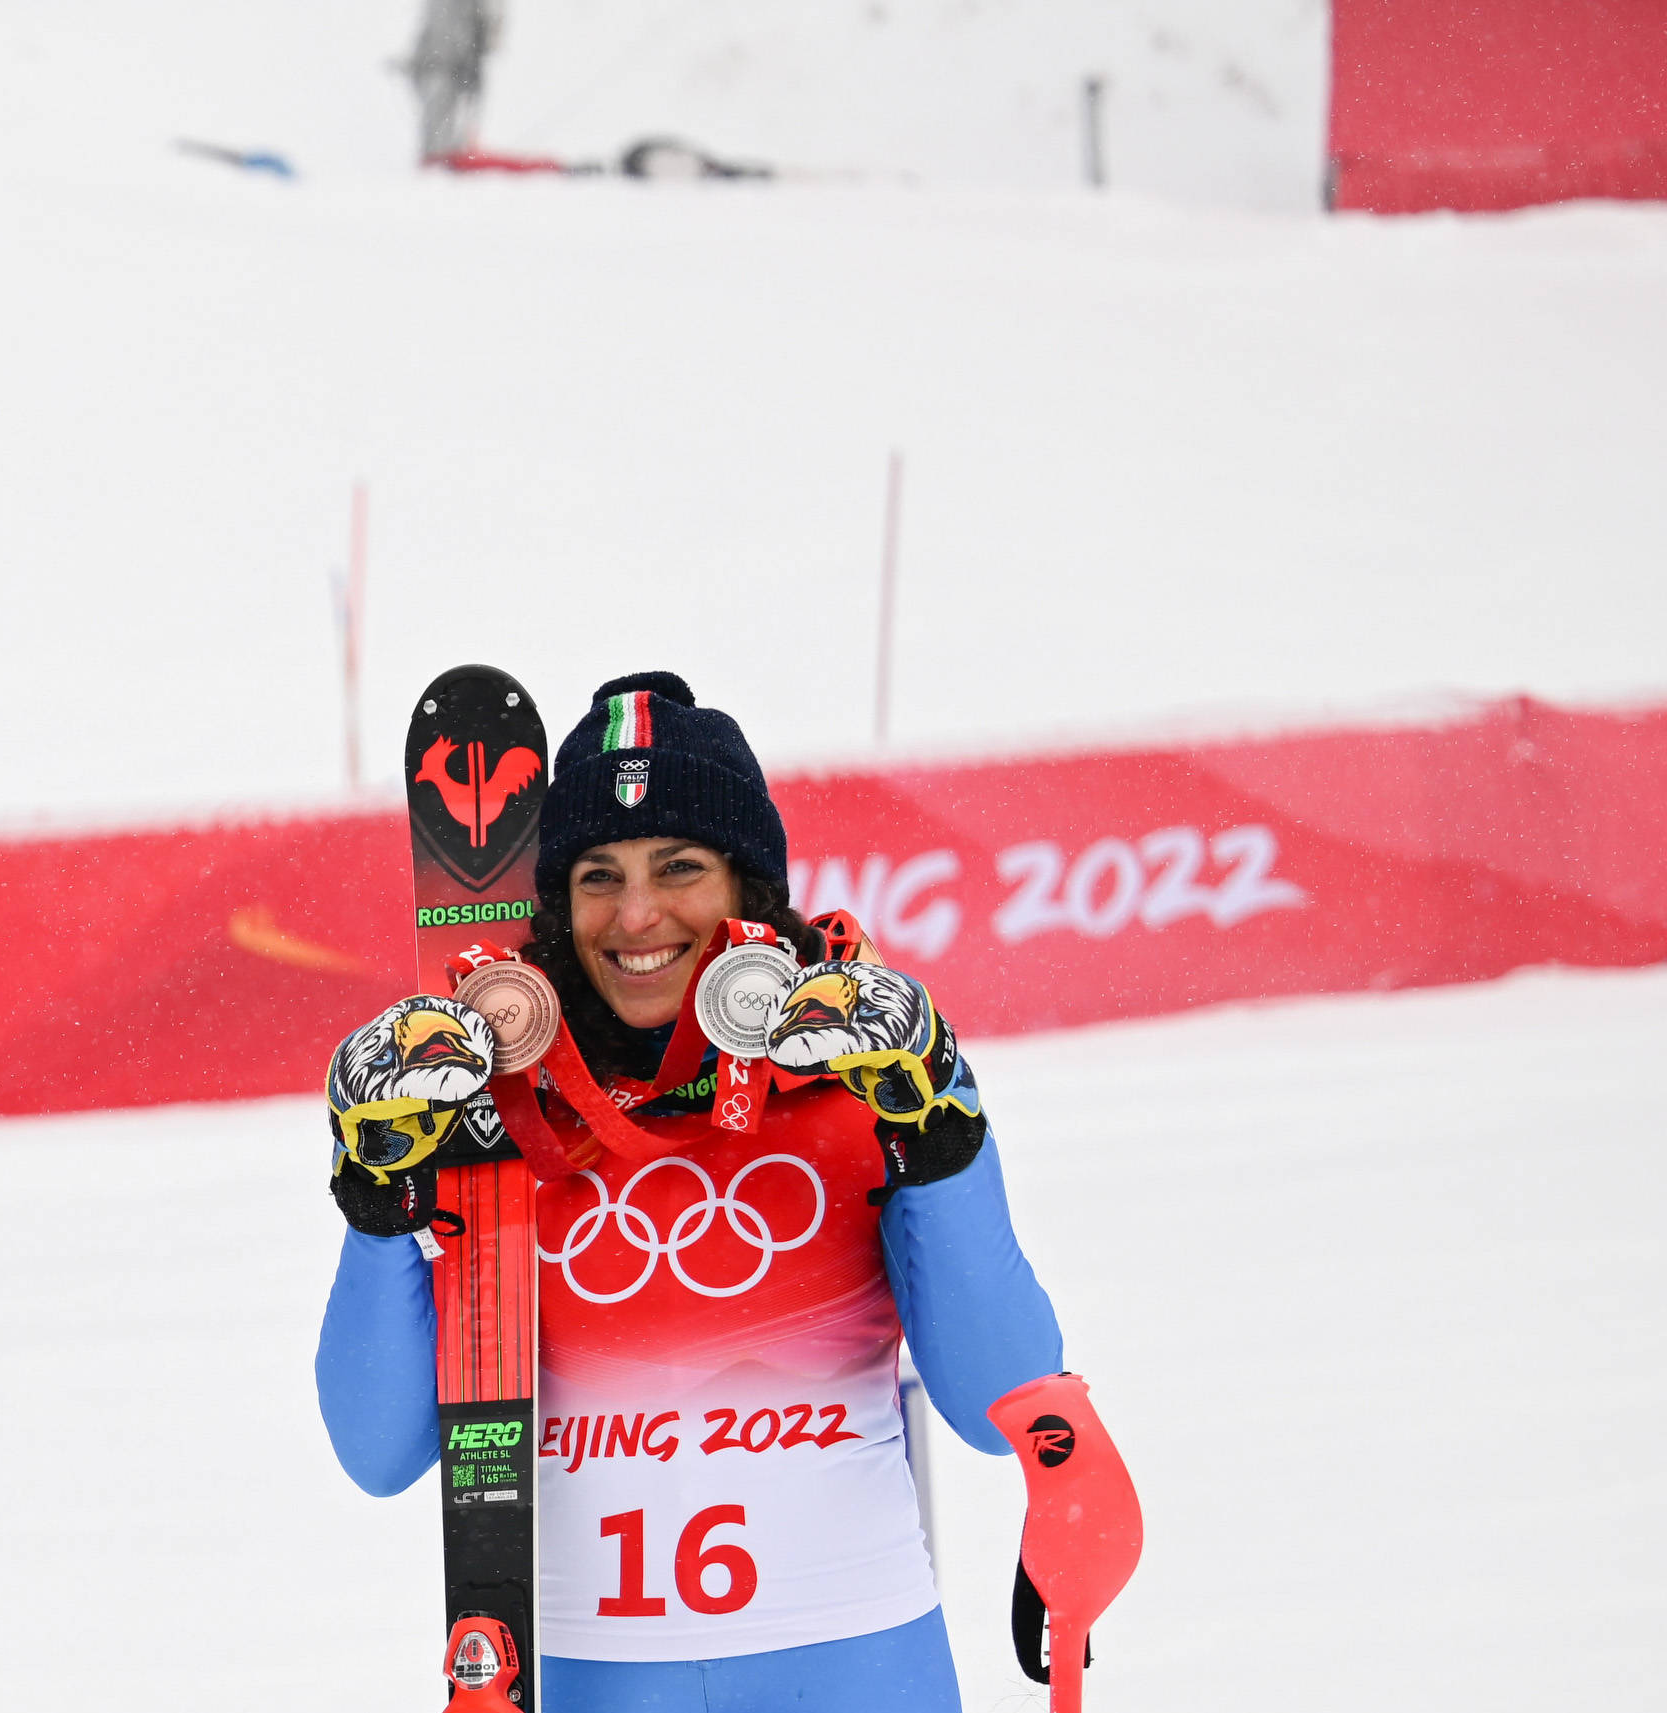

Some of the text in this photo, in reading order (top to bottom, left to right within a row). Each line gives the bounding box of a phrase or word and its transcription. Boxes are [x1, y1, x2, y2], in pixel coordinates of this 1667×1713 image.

[994, 825, 1306, 943] 2022
[418, 900, 536, 927] ROSSIGNOL
[448, 1421, 523, 1450] HERO
[539, 1403, 865, 1474] EIJING 2022
[460, 1449, 511, 1461] ATHLETE SL
[480, 1464, 512, 1473] TITANAL
[480, 1473, 499, 1484] 165
[596, 1504, 758, 1617] 16
